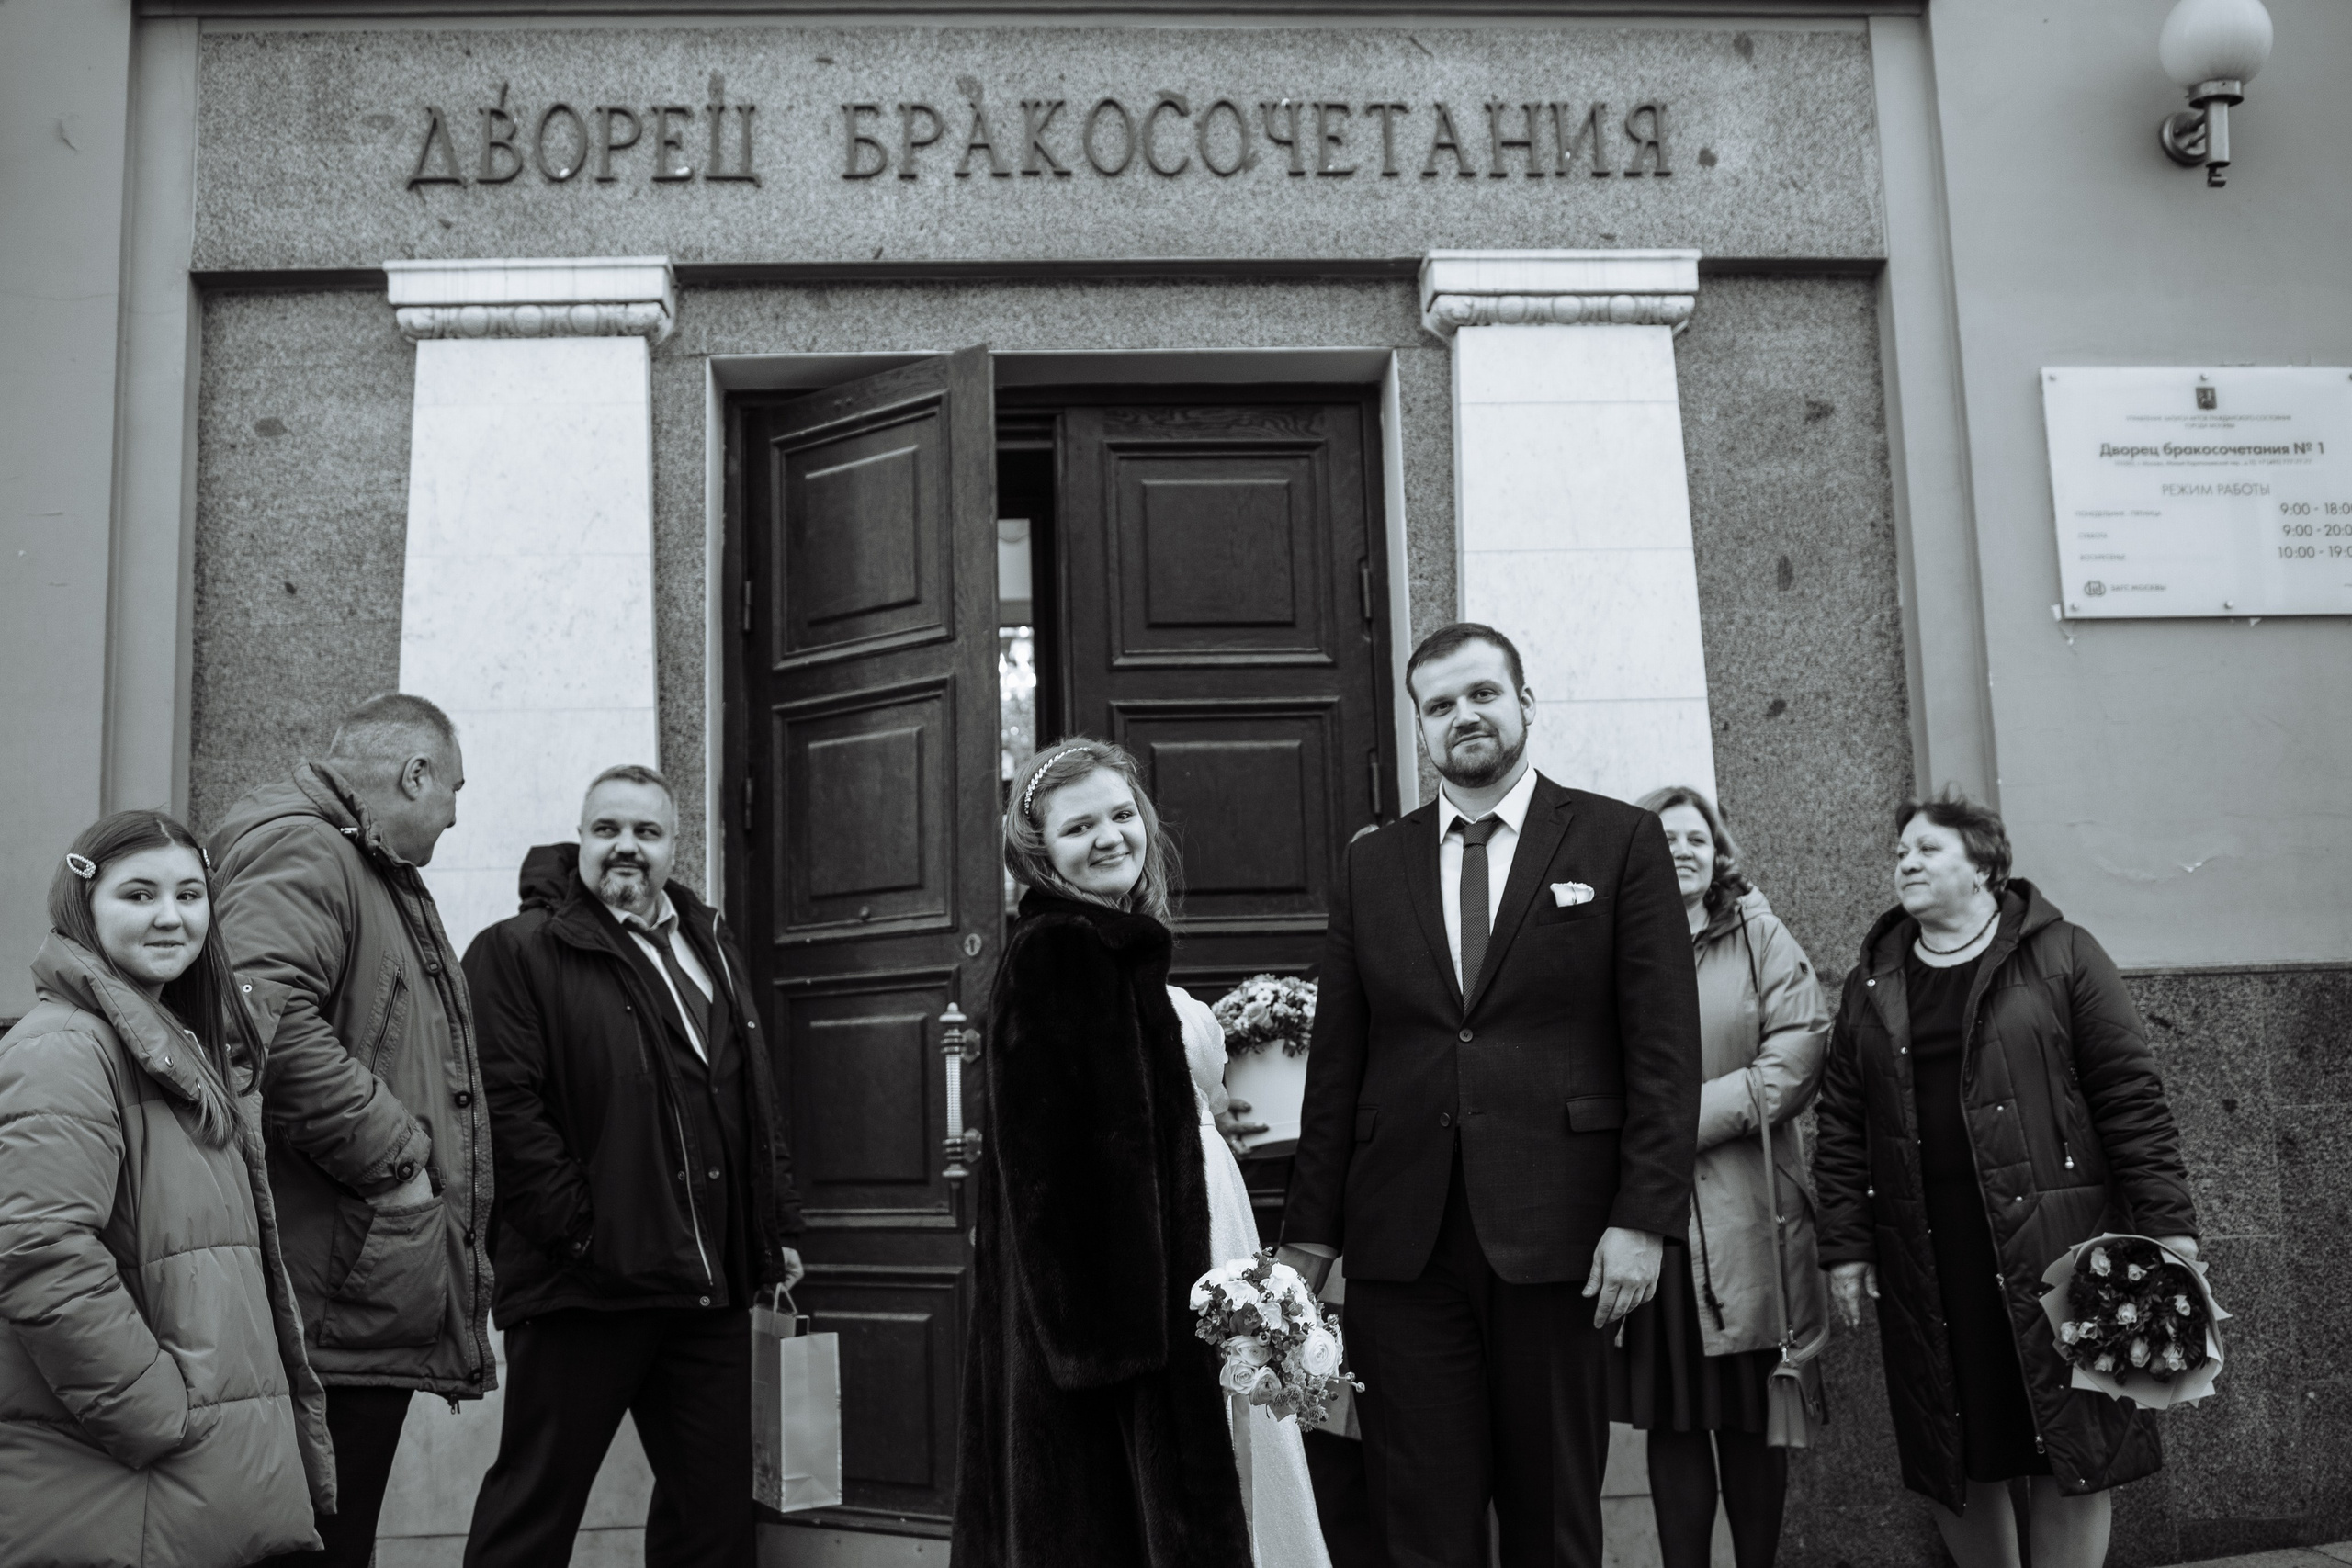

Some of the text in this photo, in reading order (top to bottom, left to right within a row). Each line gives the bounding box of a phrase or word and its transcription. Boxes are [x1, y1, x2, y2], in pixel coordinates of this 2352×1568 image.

[408, 99, 1672, 189] ДВОРЕЦ БРАКОСОЧЕТАНИЯ
[2099, 443, 2160, 458] Дворец
[2163, 442, 2290, 458] бракосочетания
[2318, 442, 2324, 455] 1
[2162, 482, 2270, 496] РЕЖИМ РАБОТЫ
[2280, 502, 2311, 515] 9:00
[2324, 502, 2352, 515] 18:0
[2283, 524, 2313, 536] 9:00
[2278, 546, 2315, 558] 10:00
